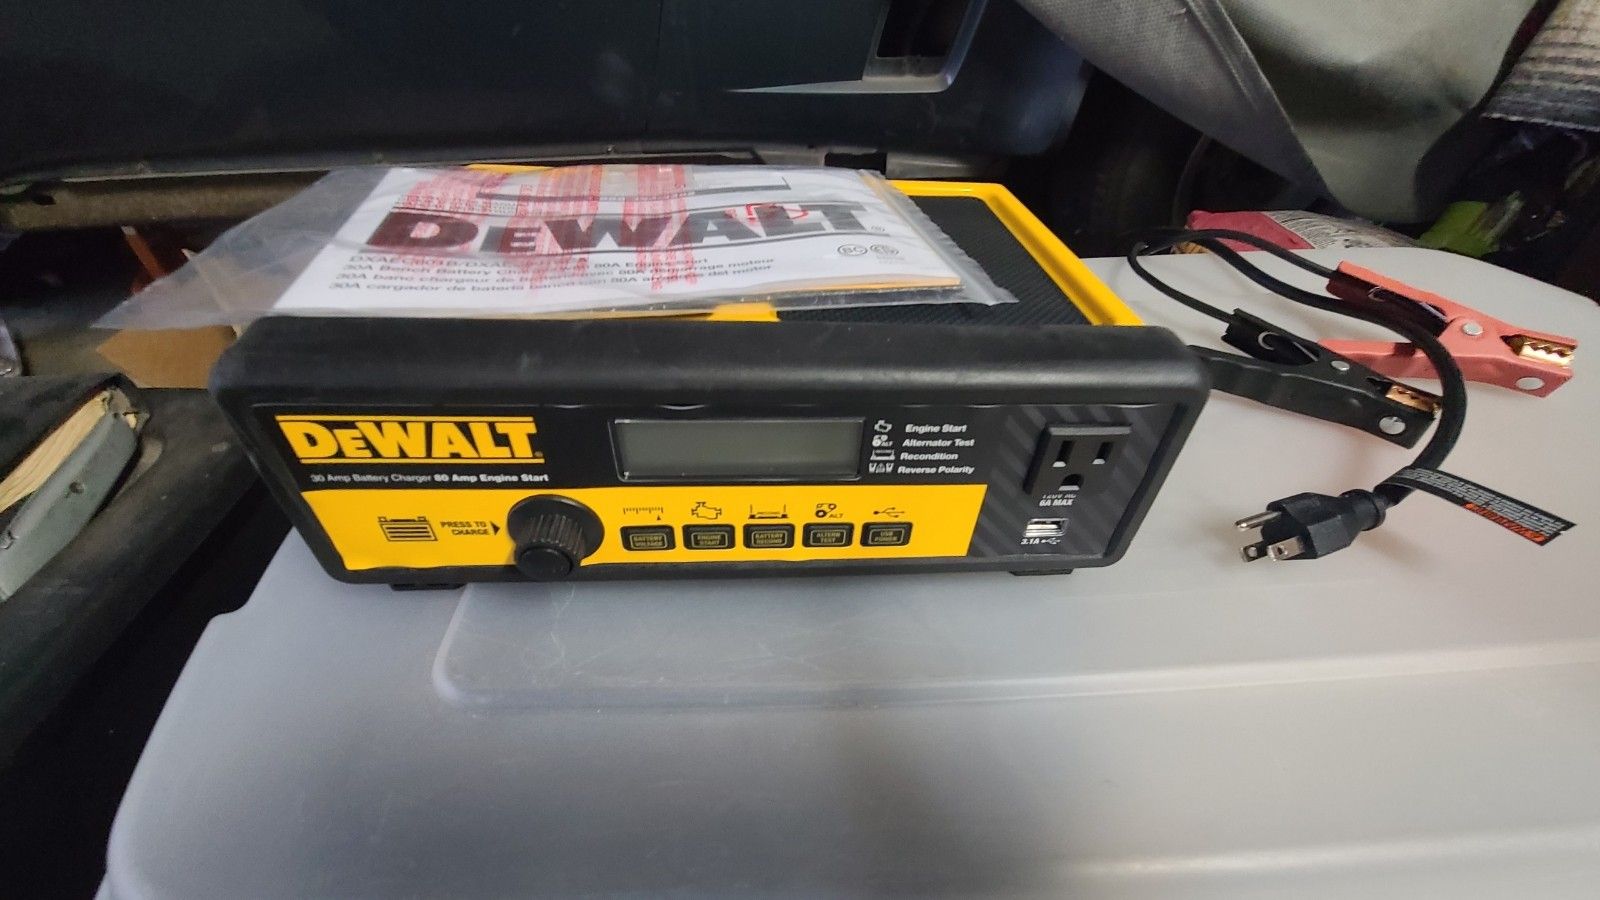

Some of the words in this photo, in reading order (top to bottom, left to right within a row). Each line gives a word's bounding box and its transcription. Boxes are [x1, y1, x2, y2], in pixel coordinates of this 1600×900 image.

[366, 203, 868, 252] DEWALT
[342, 263, 374, 272] 30A
[379, 264, 431, 274] Bench
[435, 267, 492, 277] Battery
[329, 282, 361, 290] 30A
[366, 284, 440, 292] cargador
[708, 268, 729, 277] del
[732, 265, 772, 274] motor
[335, 272, 367, 281] 30A
[419, 276, 488, 285] chargeur
[905, 423, 941, 434] Engine
[941, 423, 968, 433] Start
[278, 420, 537, 459] DEWALT
[902, 438, 952, 447] Alternator
[954, 438, 975, 447] Test
[900, 452, 959, 461] Recondition
[897, 465, 937, 474] Reverse
[938, 465, 975, 475] Polarity
[309, 473, 326, 482] 30
[326, 474, 351, 483] Amp
[352, 473, 389, 483] Battery
[390, 473, 432, 483] Charger
[451, 474, 478, 483] Amp
[479, 473, 519, 483] Engine
[520, 473, 549, 482] Start
[1039, 498, 1052, 507] 6A
[1052, 498, 1075, 506] MAX
[440, 520, 473, 528] PRESS
[473, 520, 487, 528] TO
[451, 528, 490, 536] CHARGE
